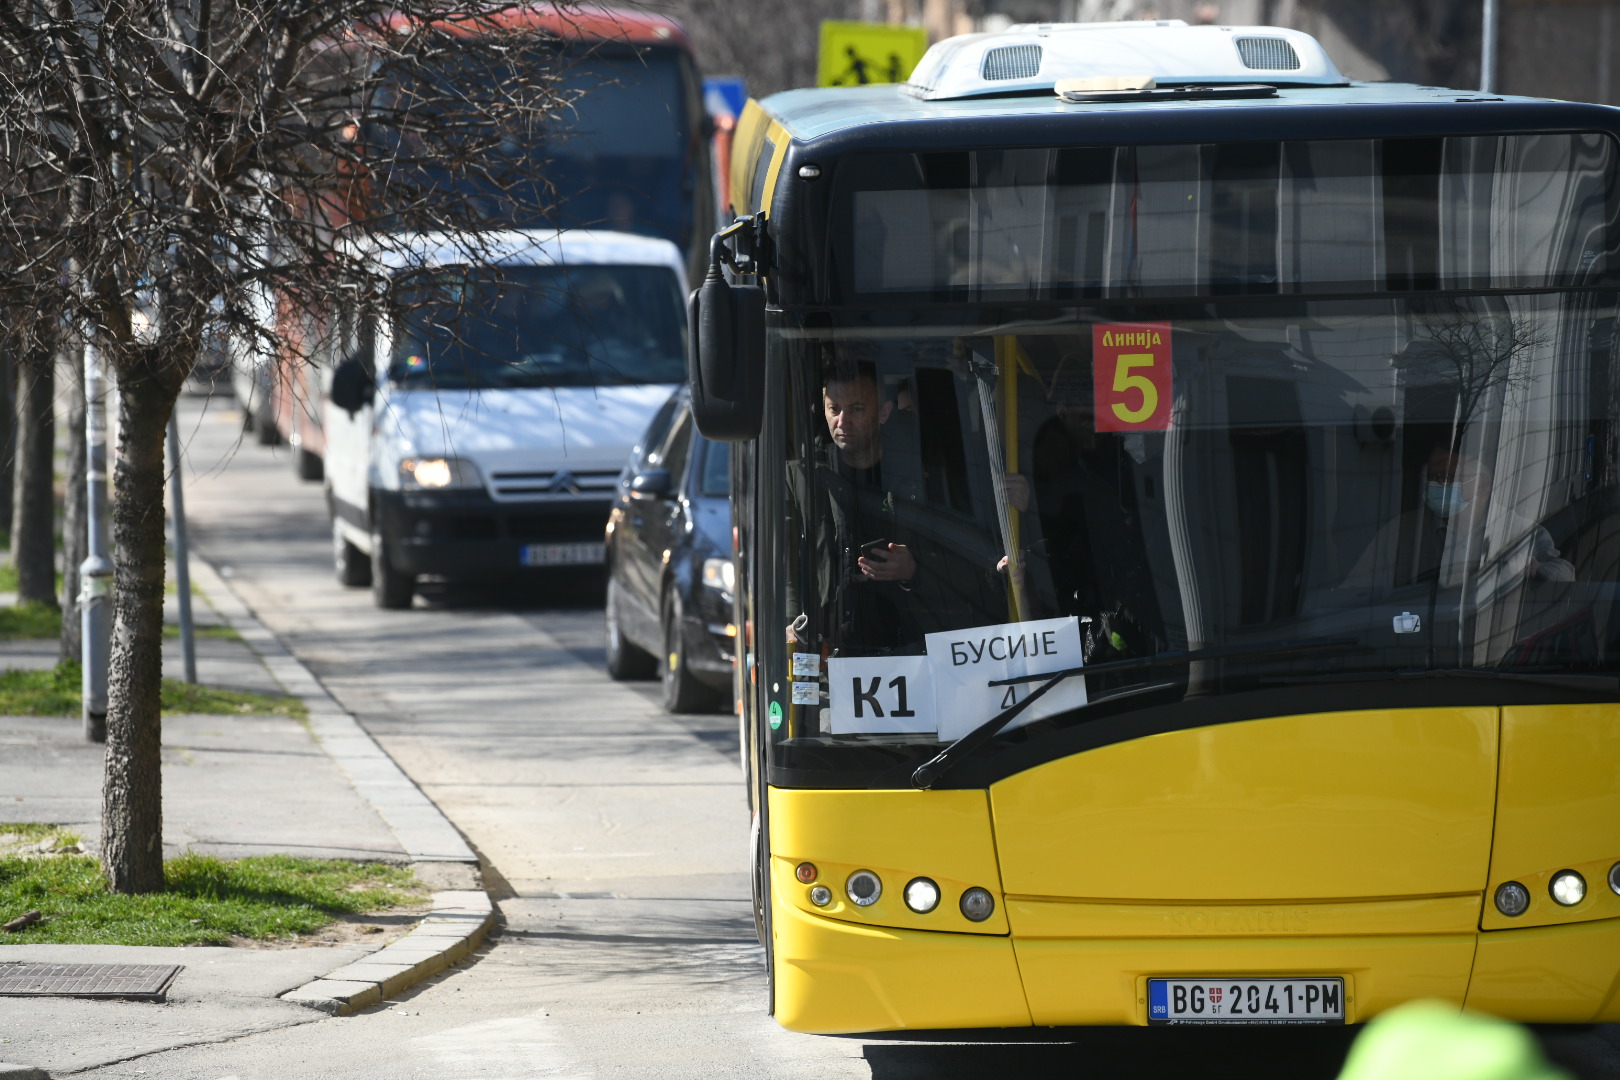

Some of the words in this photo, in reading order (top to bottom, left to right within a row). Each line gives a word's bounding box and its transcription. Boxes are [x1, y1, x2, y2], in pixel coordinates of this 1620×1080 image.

[1102, 329, 1162, 349] Линија
[1111, 353, 1159, 423] 5
[950, 631, 1058, 666] БУСИЈЕ
[1153, 1005, 1167, 1014] SRB
[1173, 985, 1205, 1014] BG
